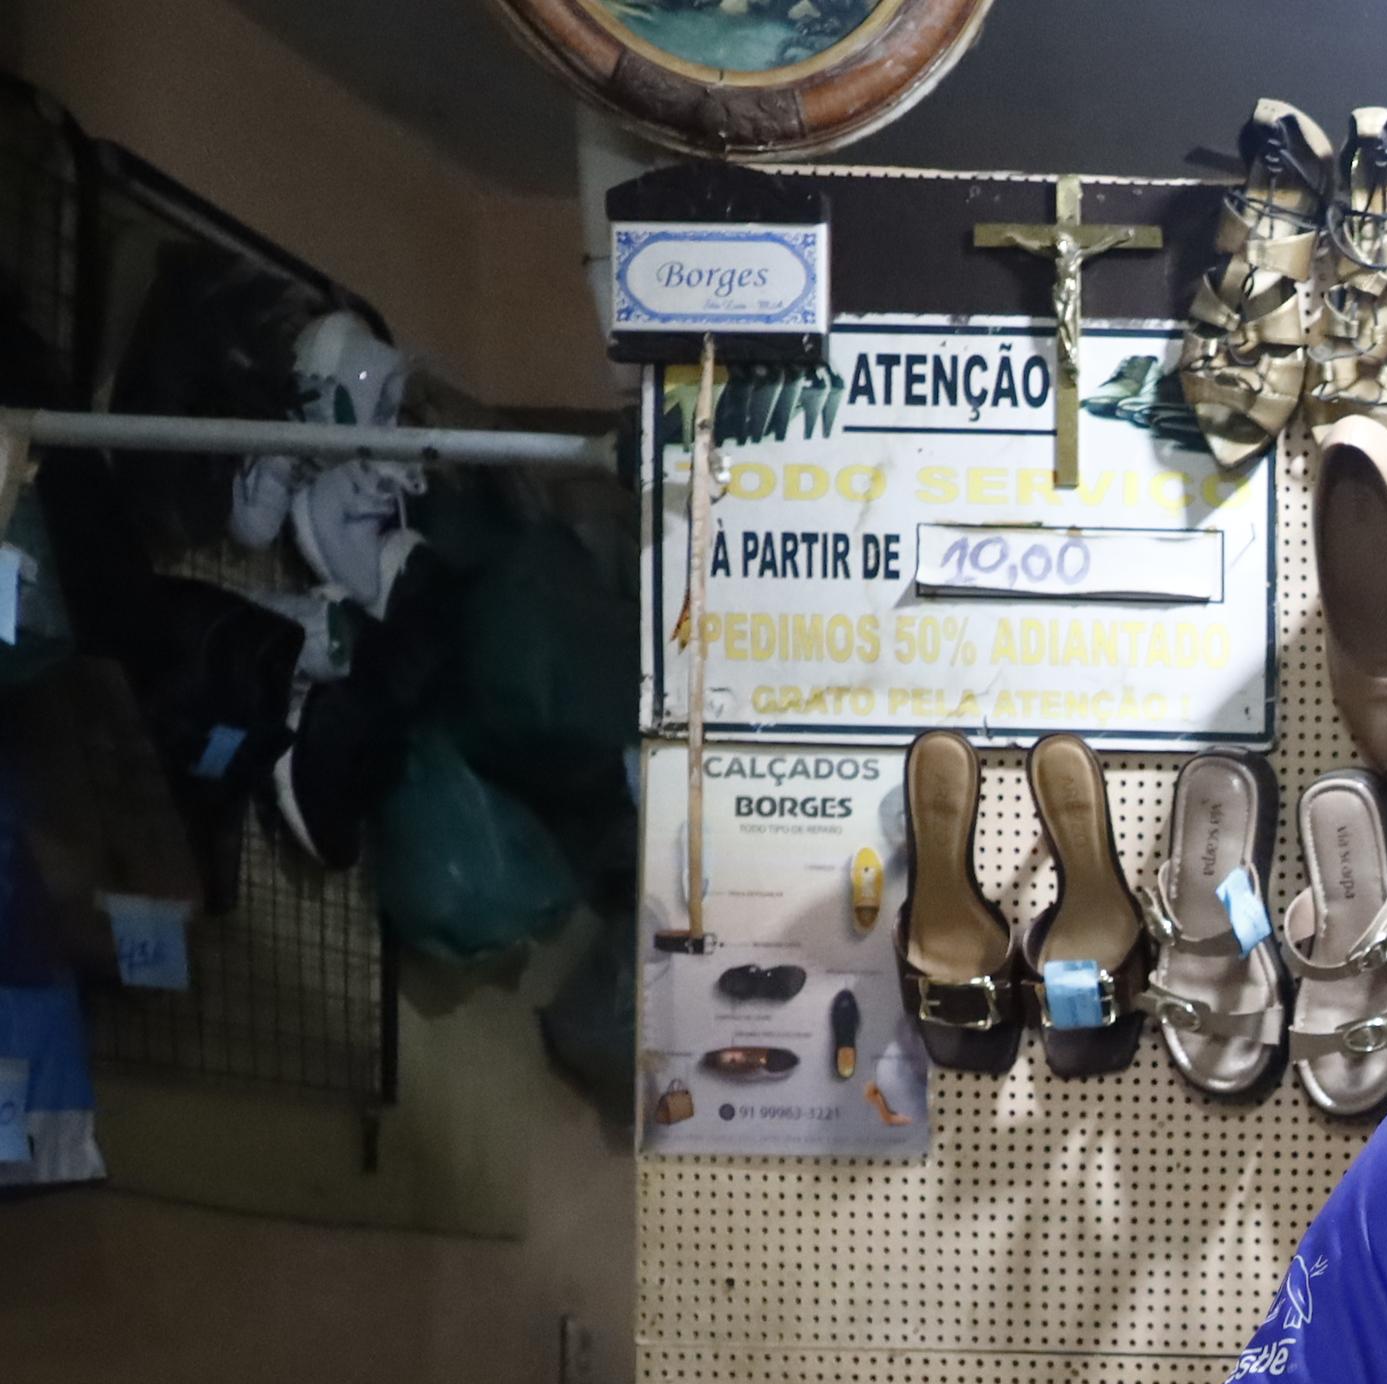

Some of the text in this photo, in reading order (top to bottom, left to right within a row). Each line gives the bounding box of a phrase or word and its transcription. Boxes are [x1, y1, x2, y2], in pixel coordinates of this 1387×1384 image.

[656, 260, 770, 297] Borges
[847, 343, 1051, 422] ATENÇÃO
[710, 518, 901, 580] À PARTIR DE
[940, 537, 1091, 586] 10,00
[701, 611, 1232, 670] PEDIMOS 50% ADIANTADO
[751, 684, 876, 726] GRATO
[887, 687, 979, 719] PELA
[991, 685, 1169, 727] ATENÇÃO
[702, 756, 880, 787] CALÇADOS
[735, 796, 853, 819] BORGES
